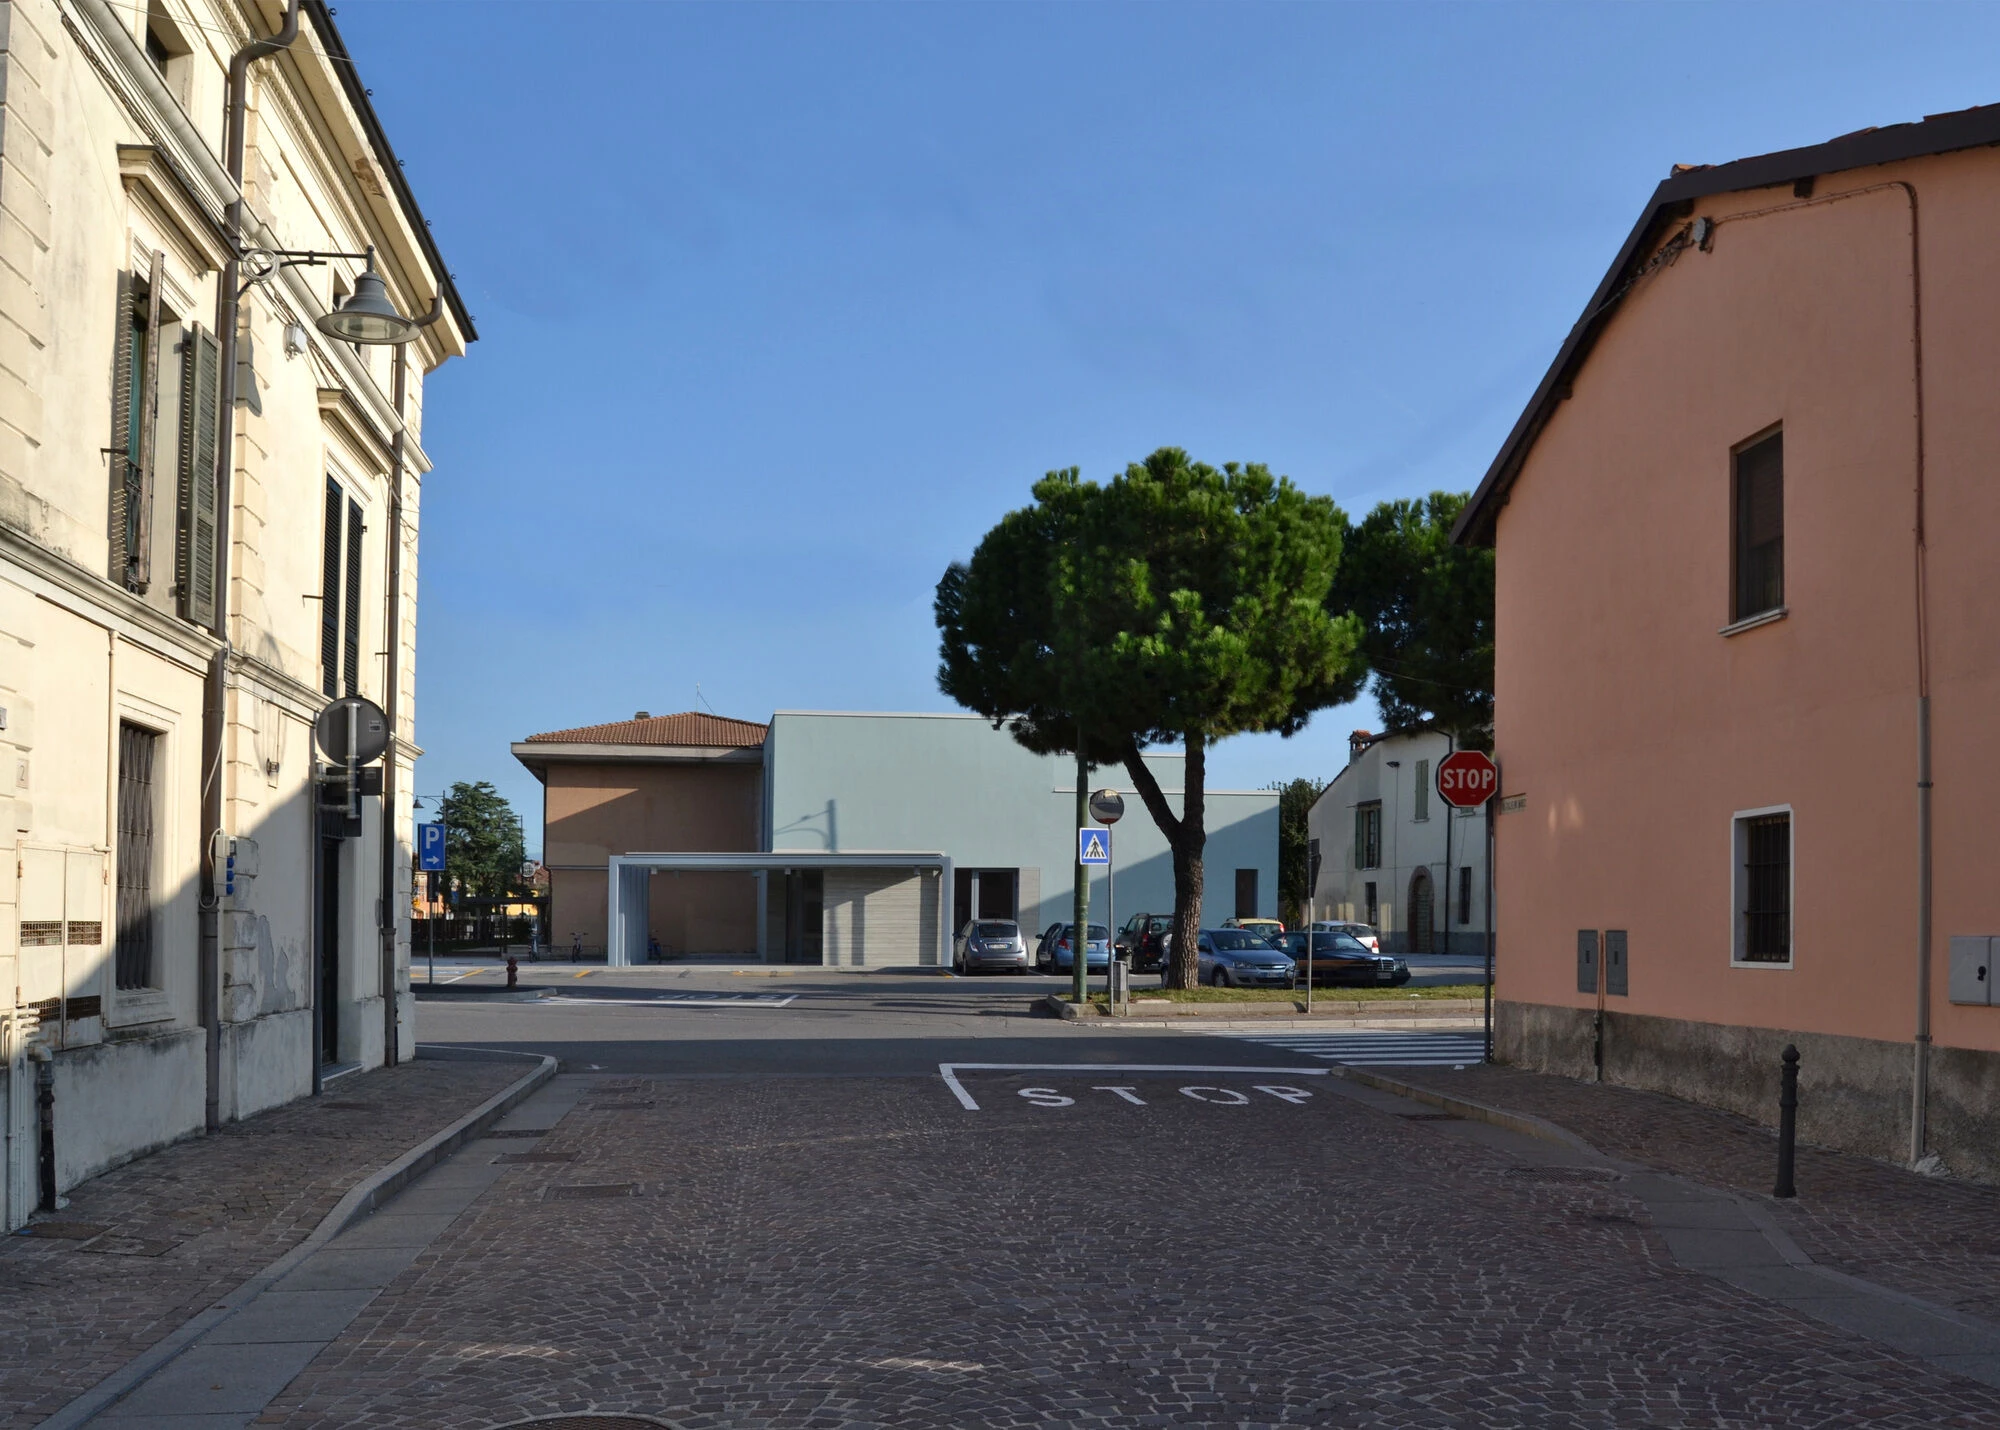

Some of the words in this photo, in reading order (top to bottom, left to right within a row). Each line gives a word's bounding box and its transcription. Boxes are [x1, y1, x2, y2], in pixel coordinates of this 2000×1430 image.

[1443, 769, 1494, 789] STOP
[426, 826, 440, 849] P
[1017, 1085, 1313, 1107] STOP
